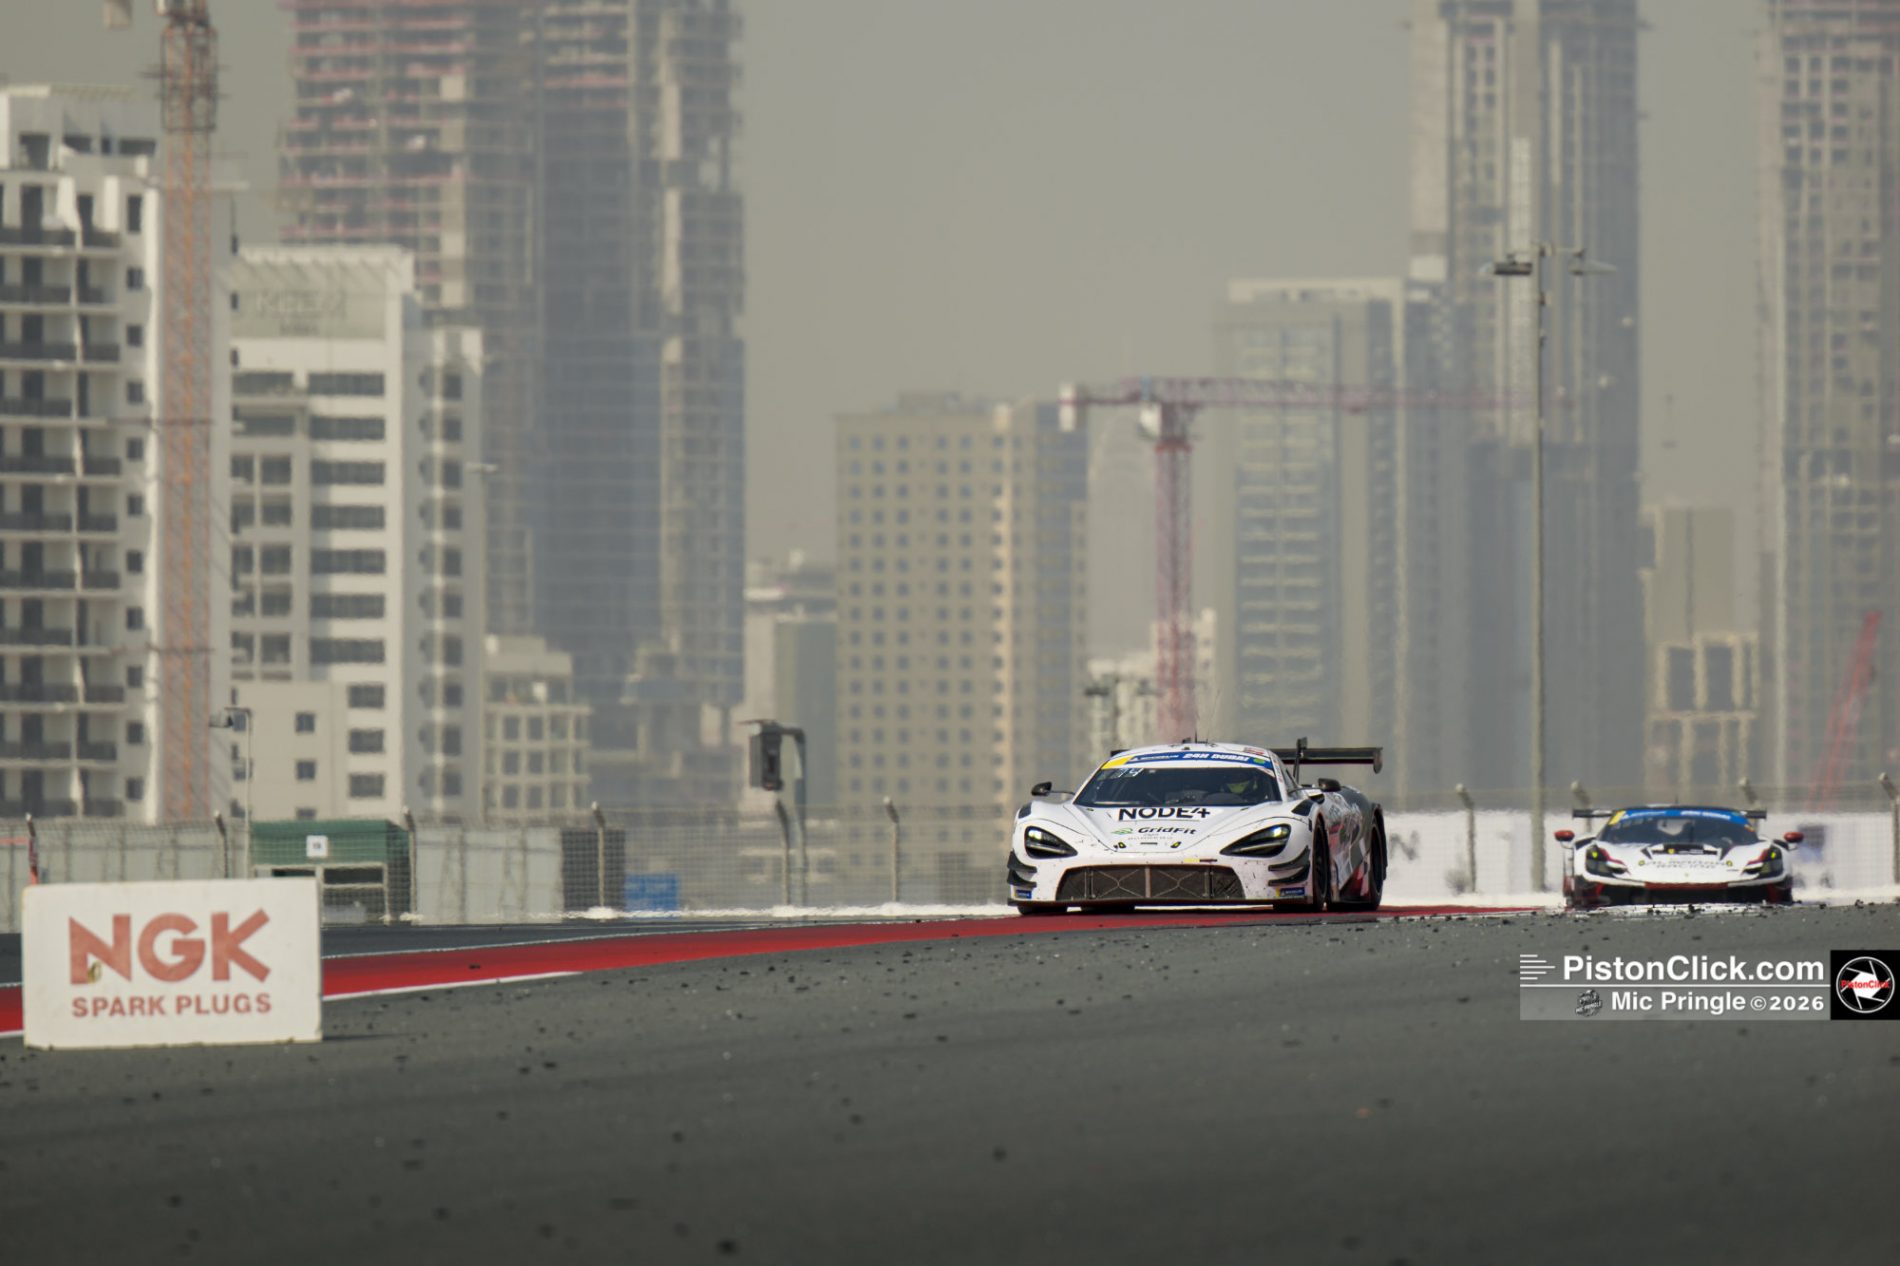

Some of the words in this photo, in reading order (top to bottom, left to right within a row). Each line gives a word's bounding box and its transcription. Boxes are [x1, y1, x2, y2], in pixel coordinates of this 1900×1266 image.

[1138, 826, 1197, 835] GridFit
[68, 908, 271, 985] NGK
[71, 995, 167, 1017] SPARK
[175, 993, 272, 1015] PLUGS
